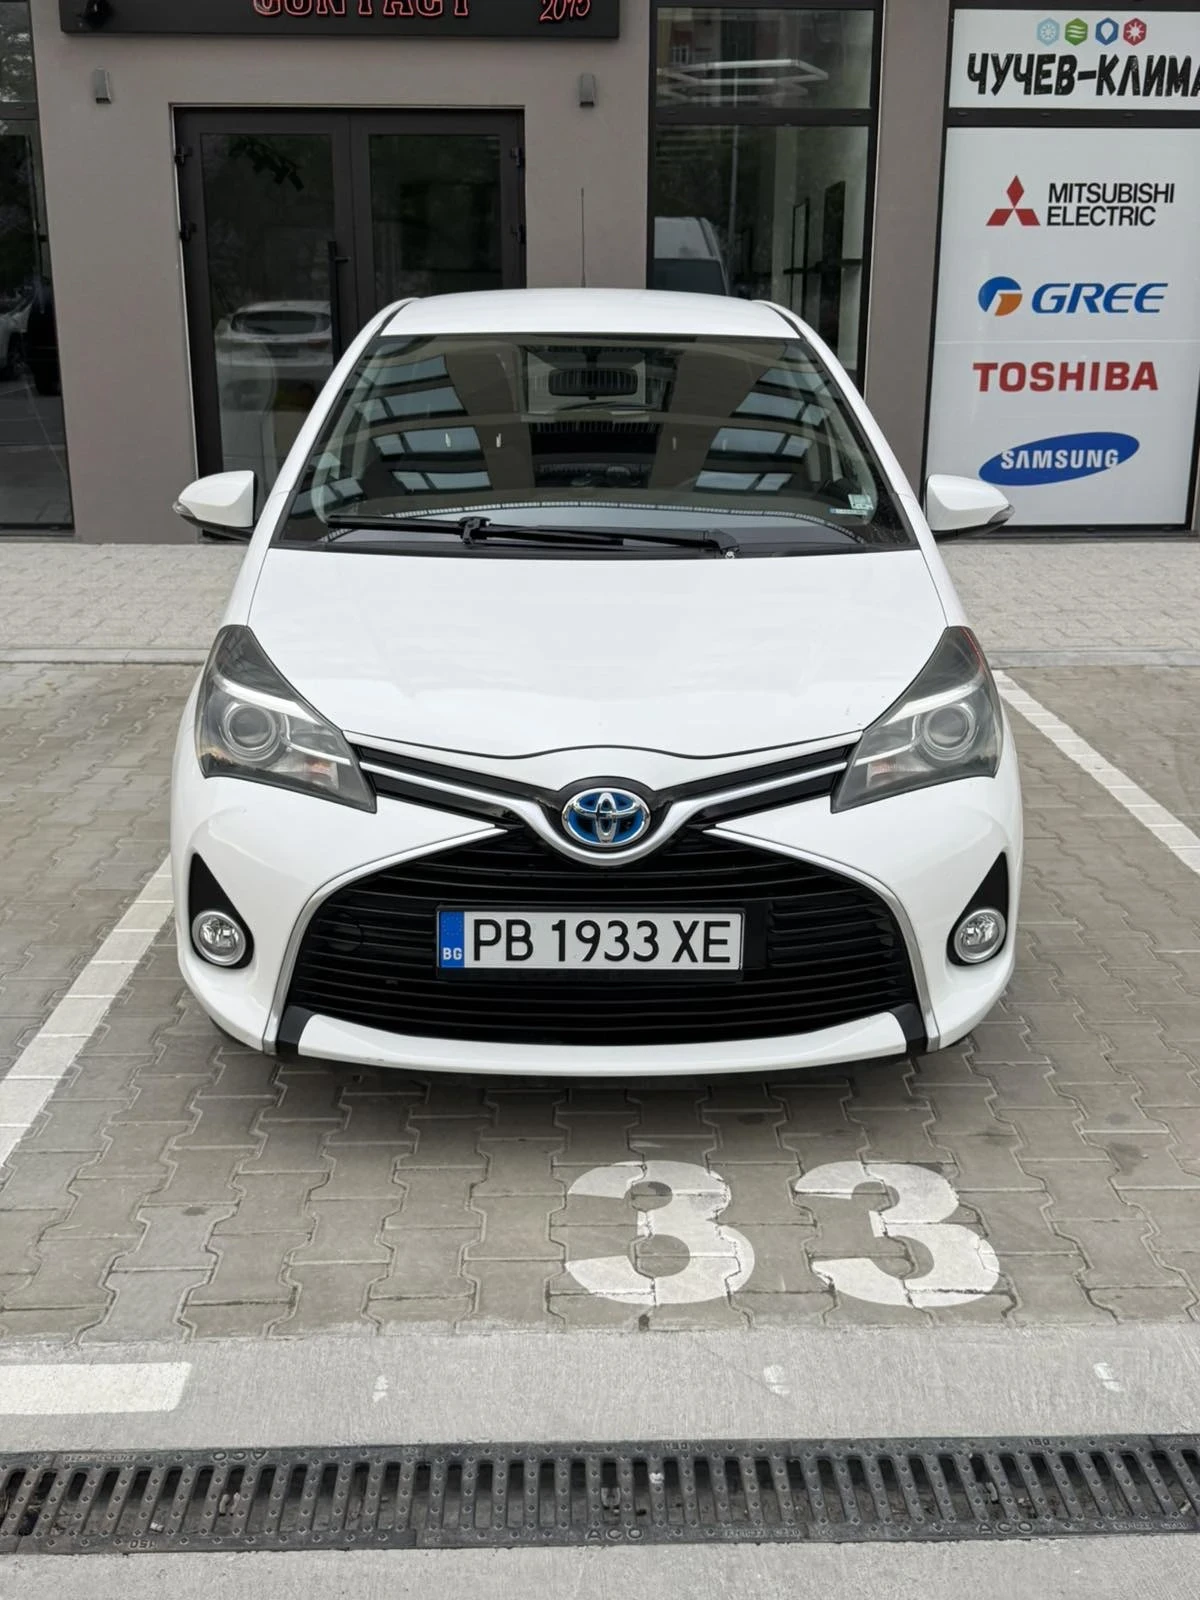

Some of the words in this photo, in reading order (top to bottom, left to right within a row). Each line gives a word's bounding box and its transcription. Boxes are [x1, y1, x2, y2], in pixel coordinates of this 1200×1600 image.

[1047, 183, 1176, 204] MITSUBISHI
[1046, 206, 1157, 227] ELECTRIC
[1031, 283, 1169, 314] GREE
[972, 361, 1159, 392] TOSHIBA
[1000, 449, 1119, 470] SAMSUNG
[473, 918, 534, 962] PB
[551, 919, 660, 963] 1933
[671, 920, 731, 963] XE
[442, 947, 463, 961] BG
[564, 1160, 1001, 1308] 33
[584, 1527, 646, 1541] ACO
